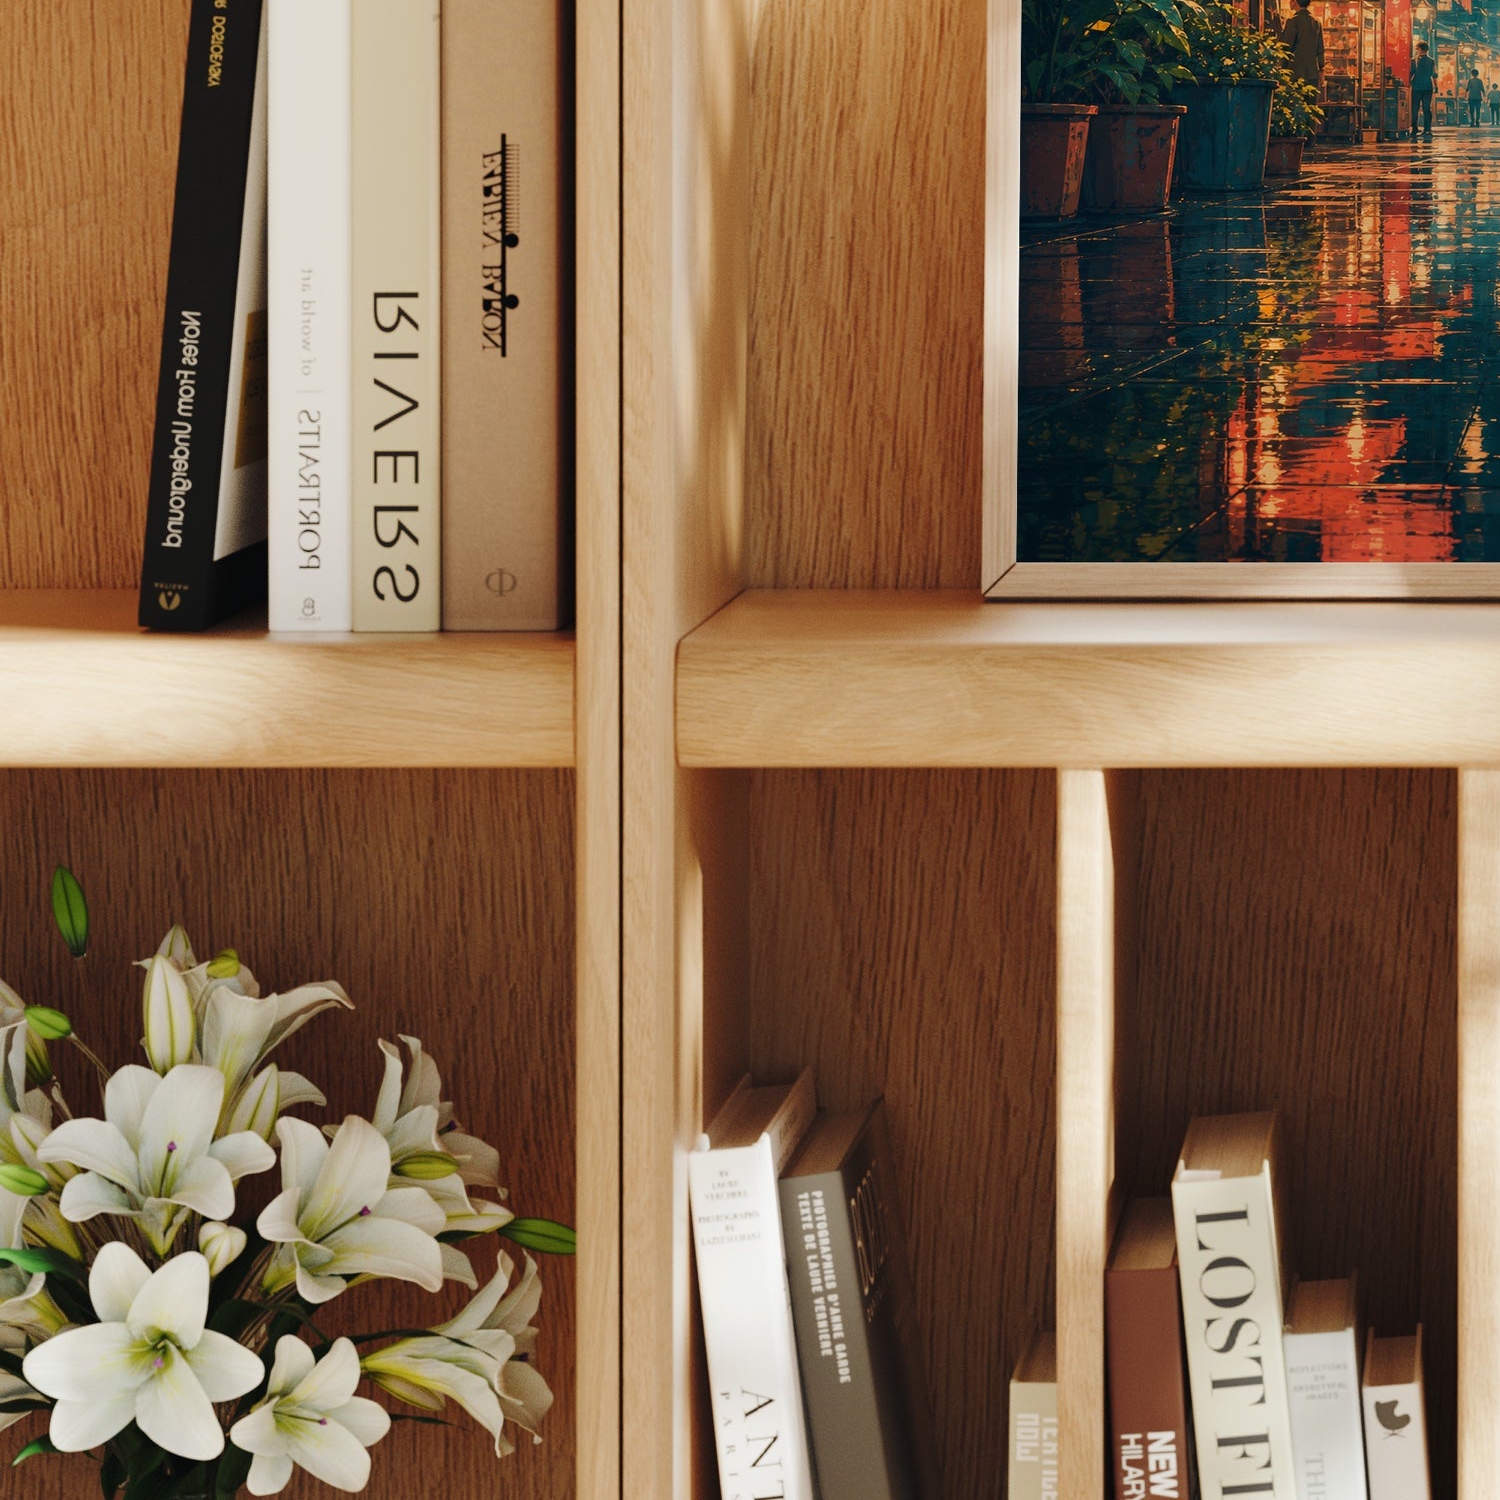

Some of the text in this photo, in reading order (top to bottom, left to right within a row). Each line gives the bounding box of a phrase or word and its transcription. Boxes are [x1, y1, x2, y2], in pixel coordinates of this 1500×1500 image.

[797, 1192, 811, 1230] TEXTE
[803, 1233, 815, 1251] DE
[806, 1254, 823, 1295] LAURE
[811, 1190, 851, 1385] PHOTOGRAPHIES D'ANNE GARDE
[1195, 1203, 1266, 1406] LOST
[1147, 1431, 1179, 1499] NEW
